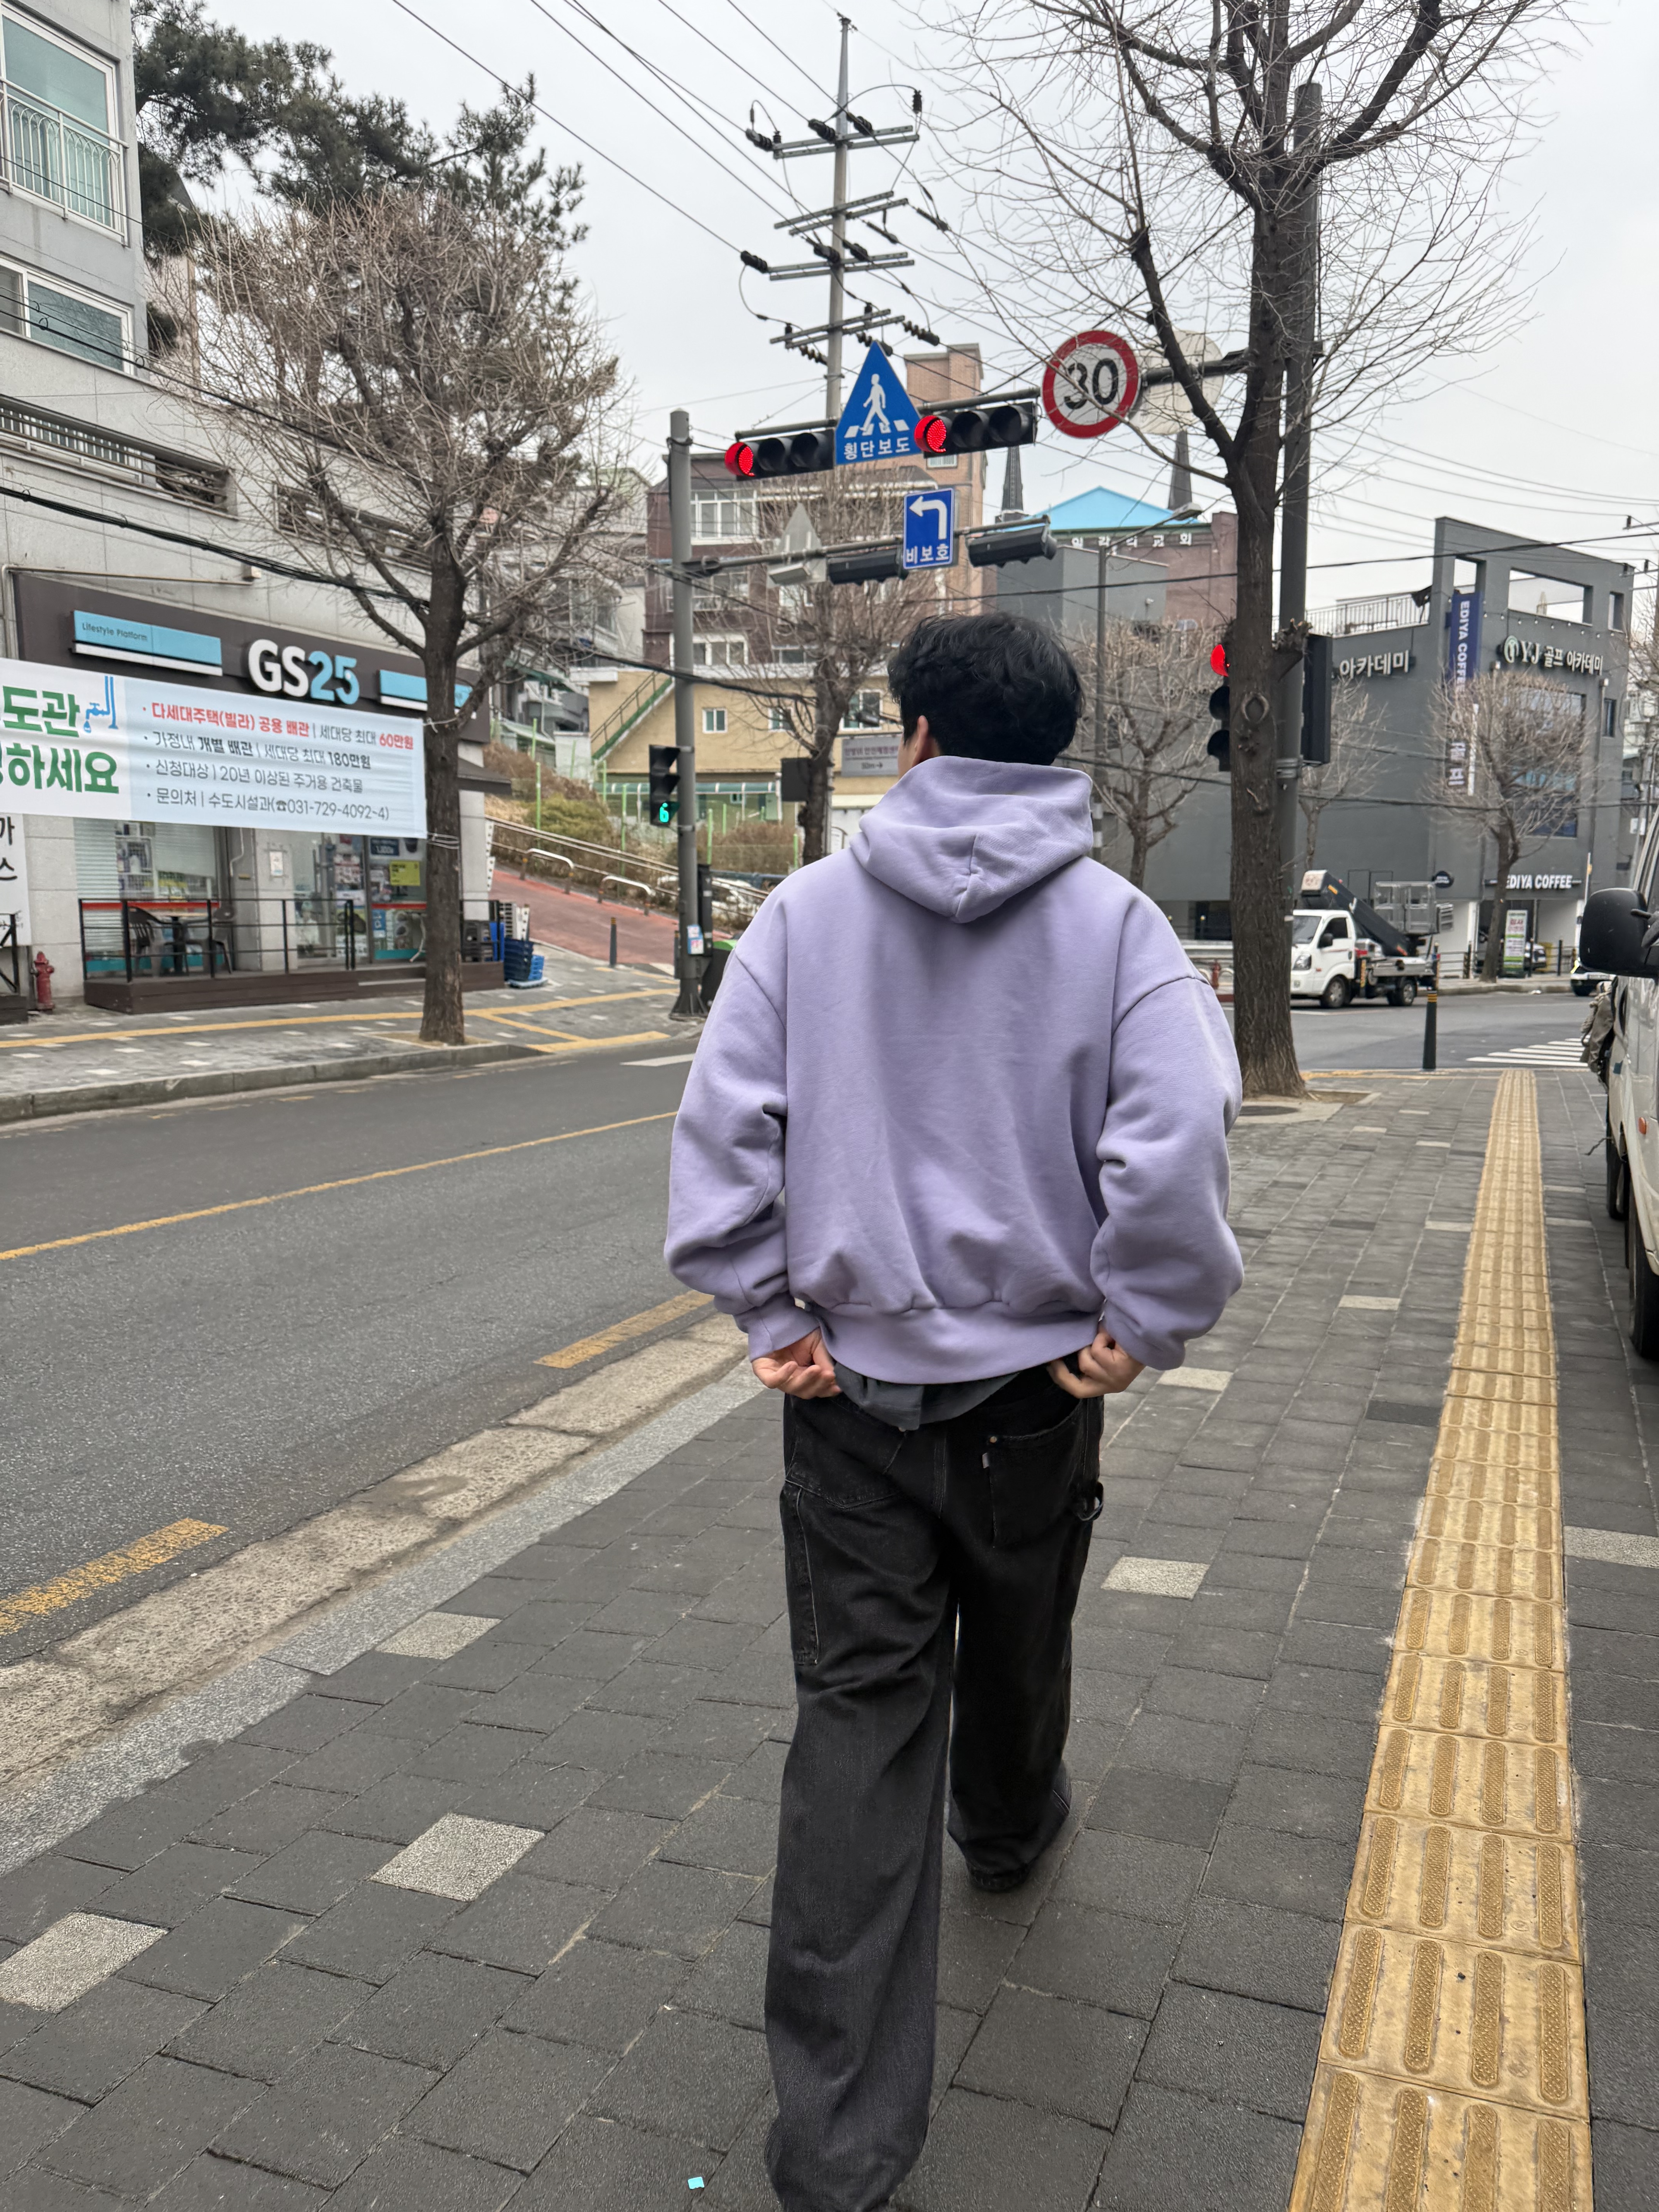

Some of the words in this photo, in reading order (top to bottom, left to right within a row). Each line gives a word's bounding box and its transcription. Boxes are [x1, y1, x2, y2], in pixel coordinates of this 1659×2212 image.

[1064, 358, 1118, 410] 30
[843, 437, 910, 460] 횡단보도
[906, 543, 949, 564] 비보호
[82, 622, 114, 636] Lifestyle
[117, 629, 148, 641] Platform
[1458, 600, 1470, 641] EDIYA
[248, 639, 360, 705] GS25
[1339, 649, 1409, 679] 아카데미
[1544, 645, 1563, 668] 골프
[1566, 650, 1604, 676] 아카데미
[151, 702, 255, 731] 다세대주택(빌라)
[259, 716, 283, 734] 공용
[286, 720, 309, 738] 배관
[320, 723, 352, 743] 세대당
[356, 729, 377, 746] 최대
[379, 733, 414, 750] 60만원
[153, 730, 195, 751] 가정내
[198, 737, 225, 754] 개별
[228, 739, 254, 757] 배관
[265, 743, 299, 763] 세대당
[302, 748, 326, 764] 최대
[328, 751, 371, 770] 180만원
[0, 740, 120, 794] 하세요
[156, 759, 209, 780] 신청대상
[220, 765, 250, 783] 20년
[254, 769, 290, 787] 이상된
[293, 772, 328, 791] 주거용
[331, 776, 363, 794] 건축물
[156, 787, 196, 807] 문의처
[1534, 874, 1573, 889] COFFEE
